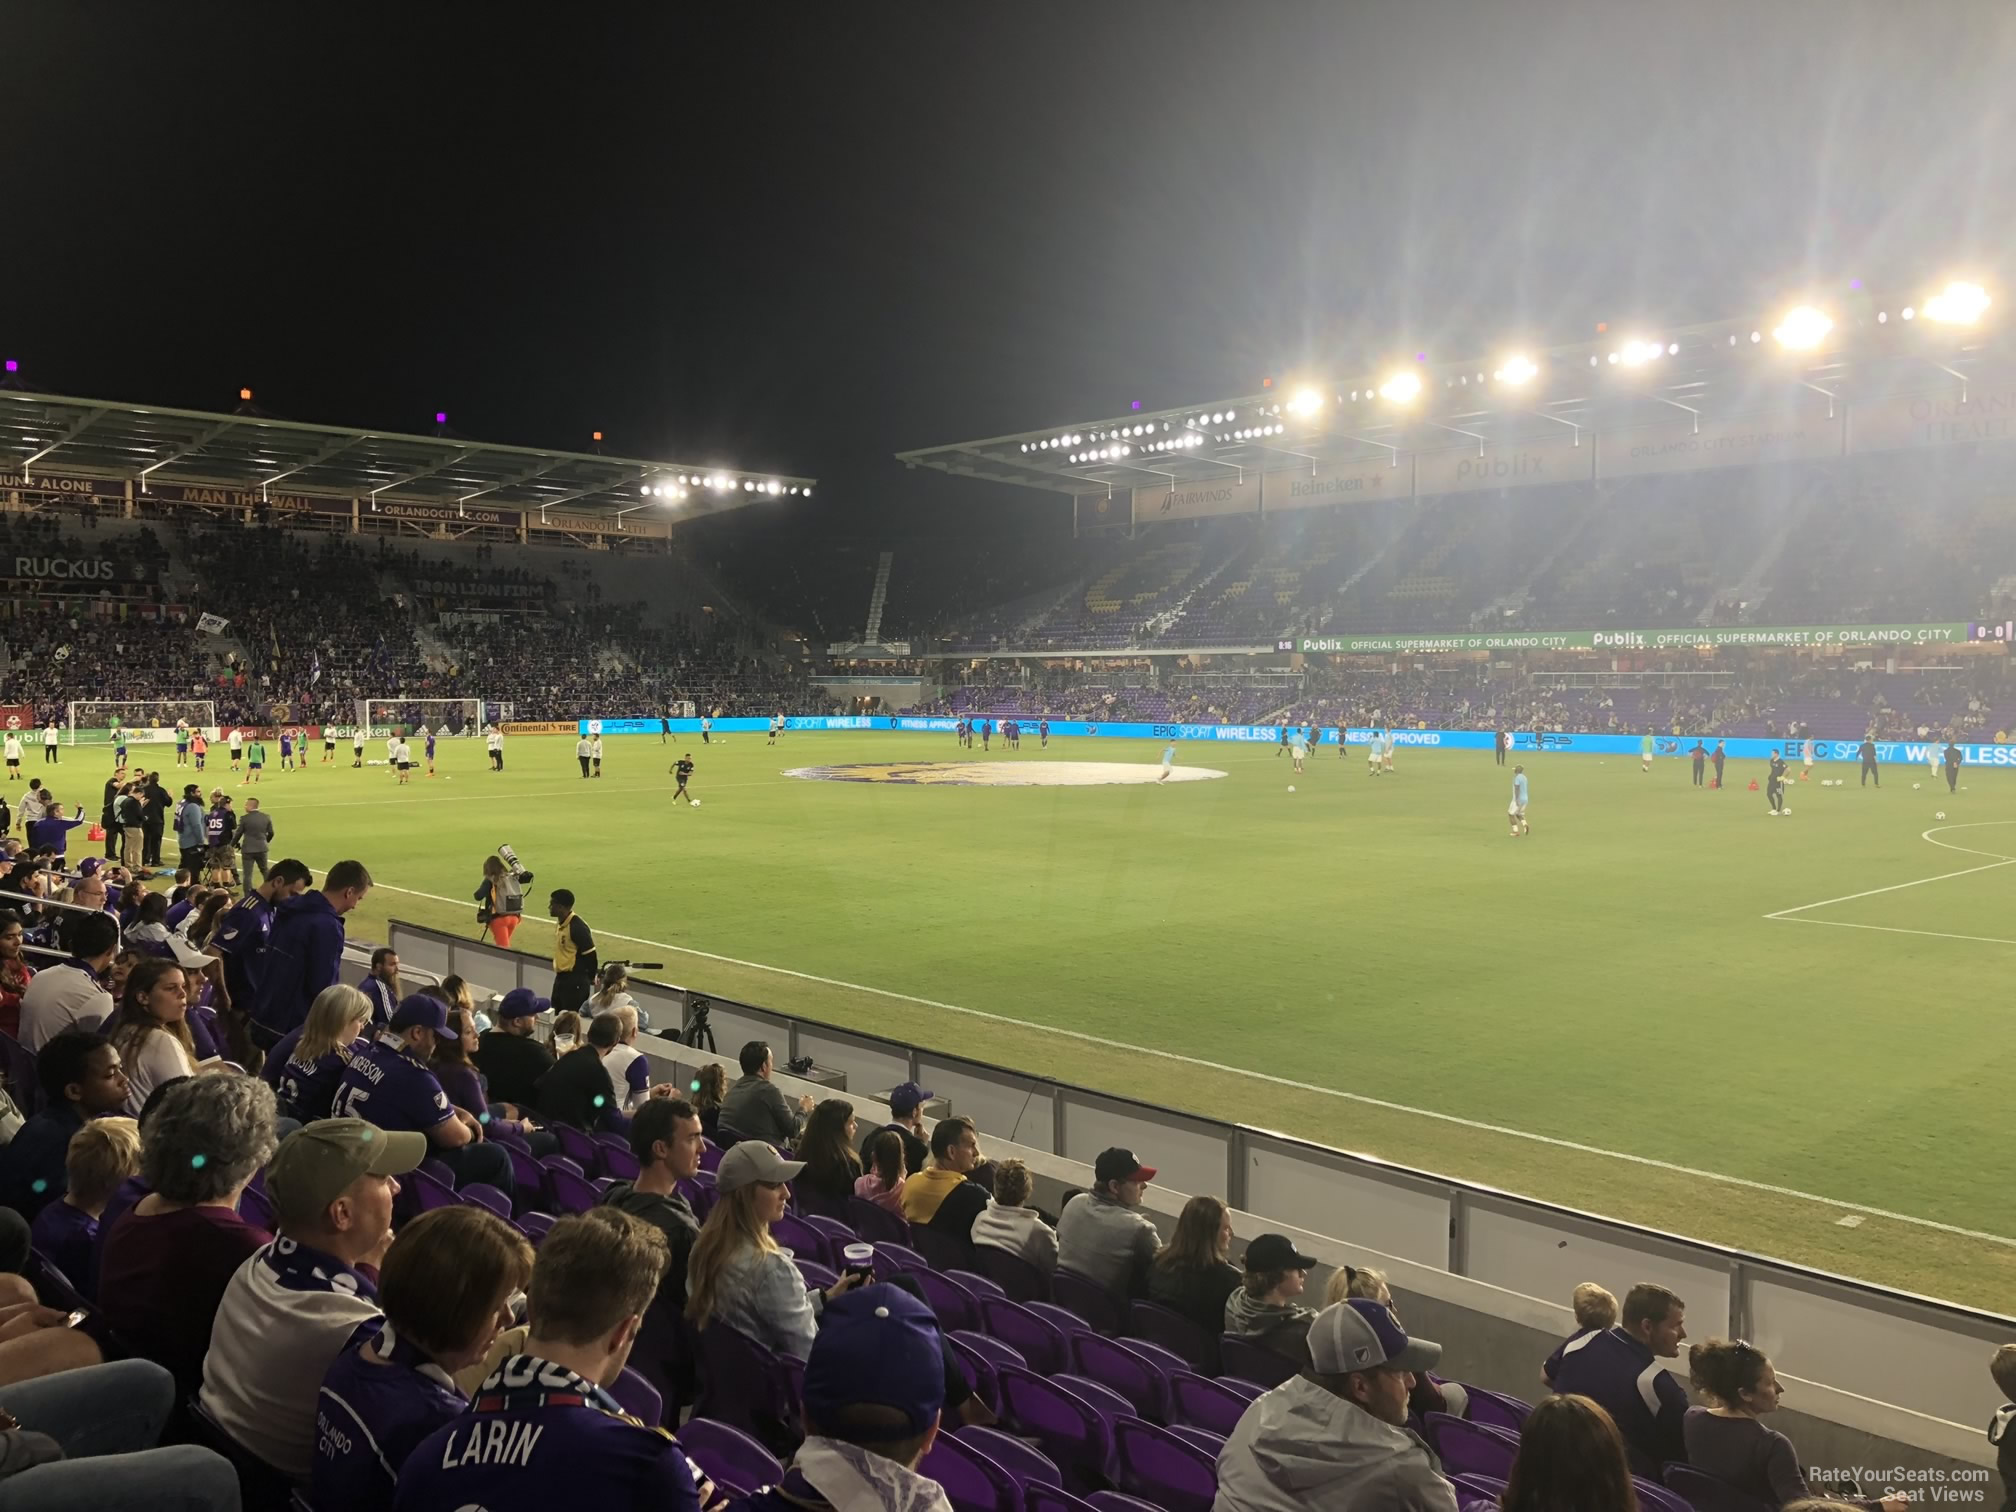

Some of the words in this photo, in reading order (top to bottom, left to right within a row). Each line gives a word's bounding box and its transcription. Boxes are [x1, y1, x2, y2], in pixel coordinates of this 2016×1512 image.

[1630, 440, 1699, 458] ORLANDO
[1703, 437, 1736, 450] CITY
[1457, 452, 1543, 481] Publix
[40, 478, 93, 492] ALONE
[1290, 476, 1363, 497] Heineken
[183, 487, 226, 503] MAN
[1173, 488, 1232, 506] FAIRWINDS
[15, 557, 114, 580] RUCKUS
[503, 584, 545, 597] FIRM
[1303, 639, 1341, 650] Publix
[1351, 640, 1392, 650] OFFICIAL
[1396, 639, 1464, 649] SUPERMARKET
[1468, 638, 1482, 648] OF
[1485, 637, 1538, 647] ORLANDO
[1542, 637, 1567, 646] CITY
[1593, 632, 1643, 645] Publix
[1657, 634, 1711, 644] OFFICIAL
[1716, 632, 1810, 643] SUPERMARKET
[1815, 631, 1833, 642] OF
[1839, 630, 1911, 641] ORLANDO
[1917, 629, 1952, 640] CITY
[501, 723, 549, 734] Continental
[558, 724, 577, 732] TIRE
[826, 717, 872, 729] WIRELESS
[1153, 725, 1176, 737] EPIC
[1179, 726, 1213, 738] SPORT
[1215, 727, 1277, 740] WIRELESS
[318, 1411, 352, 1454] ORLANDO
[442, 1420, 544, 1470] LARIN
